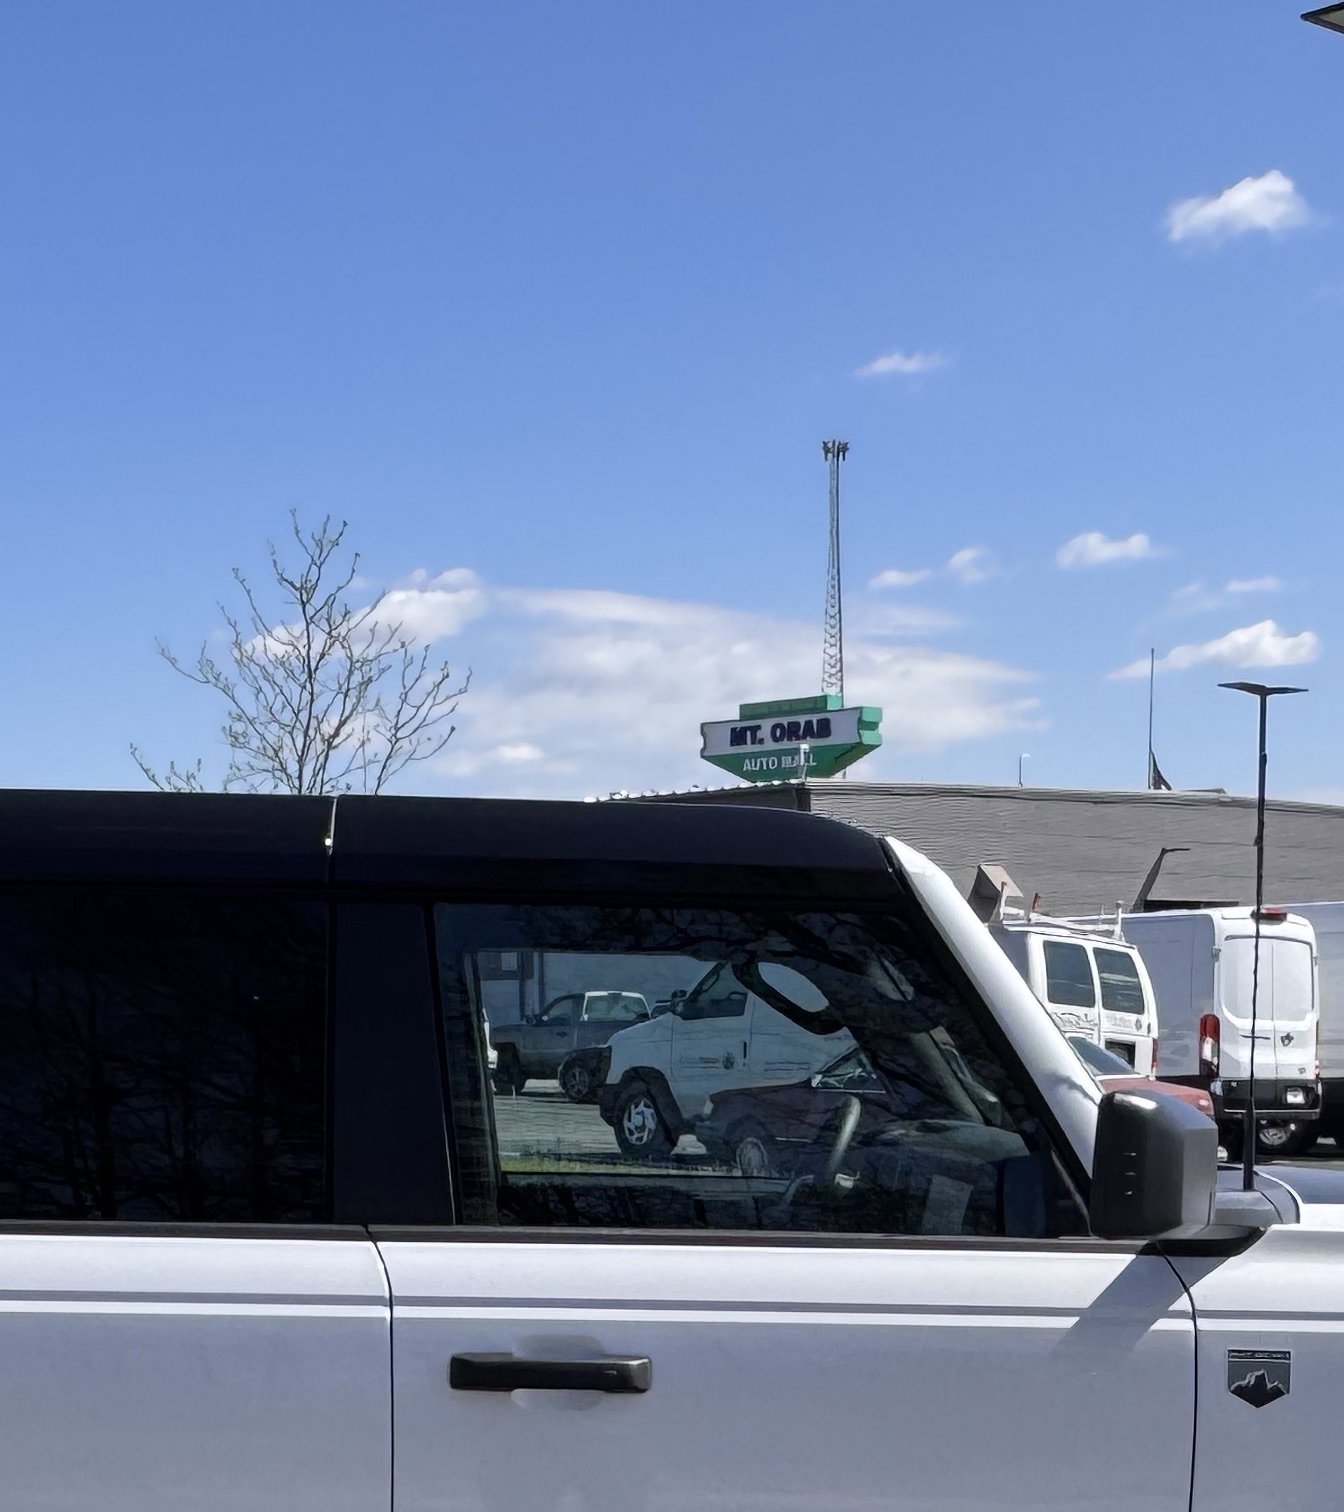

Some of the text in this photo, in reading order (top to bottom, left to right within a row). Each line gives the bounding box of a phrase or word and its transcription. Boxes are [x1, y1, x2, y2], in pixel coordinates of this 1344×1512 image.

[770, 718, 832, 743] ORAB
[743, 753, 817, 771] AUTO MAL
